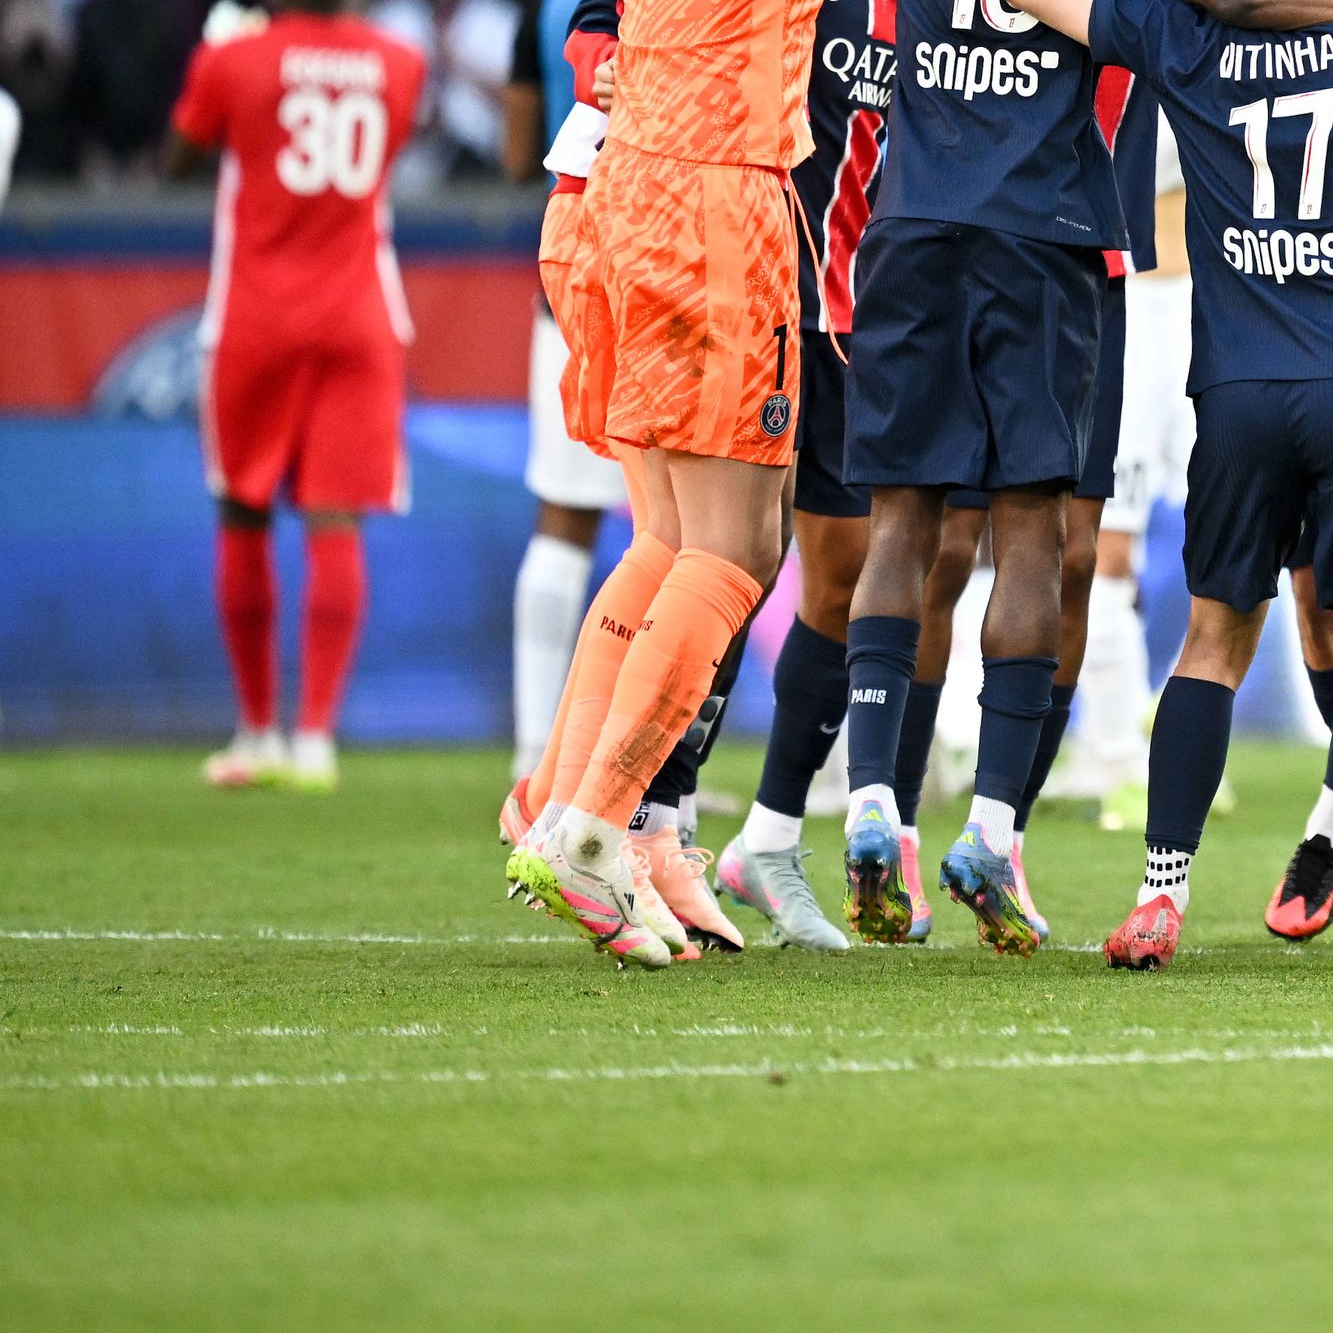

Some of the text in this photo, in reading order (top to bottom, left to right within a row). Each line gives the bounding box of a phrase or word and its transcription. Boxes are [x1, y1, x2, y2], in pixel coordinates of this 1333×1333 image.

[274, 86, 390, 200] 30
[773, 323, 788, 391] 1
[600, 615, 636, 642] PARI
[850, 688, 887, 705] PARIS
